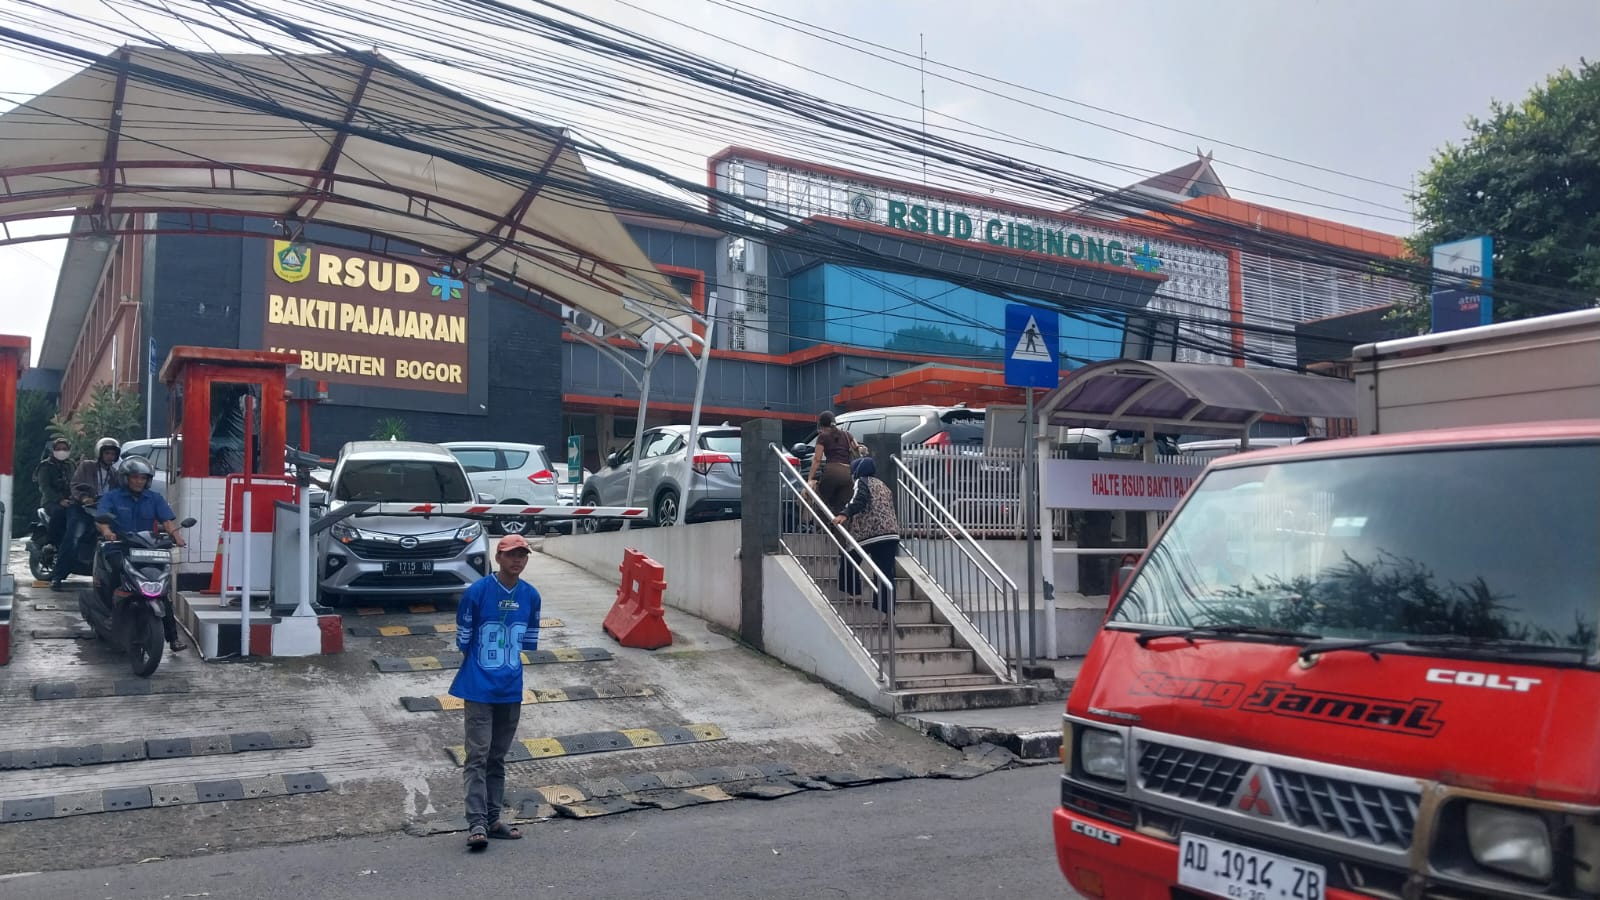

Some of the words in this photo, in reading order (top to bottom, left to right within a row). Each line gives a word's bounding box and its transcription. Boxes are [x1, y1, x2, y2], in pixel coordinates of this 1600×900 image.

[888, 202, 973, 241] RSUD
[985, 217, 1125, 267] CIBINONG
[317, 253, 421, 293] RSUD
[268, 294, 336, 330] BAKTI
[339, 303, 466, 344] PAJAJARAN
[270, 347, 385, 376] BUPATEN
[395, 360, 463, 384] BOGOR
[1091, 473, 1119, 497] HALTE
[1121, 474, 1145, 497] RSUD
[1147, 475, 1172, 498] BAKTI
[384, 562, 391, 571] F
[399, 561, 416, 571] 1715
[1425, 668, 1542, 693] COLT
[1071, 821, 1121, 846] COLT
[1183, 840, 1209, 872] AD
